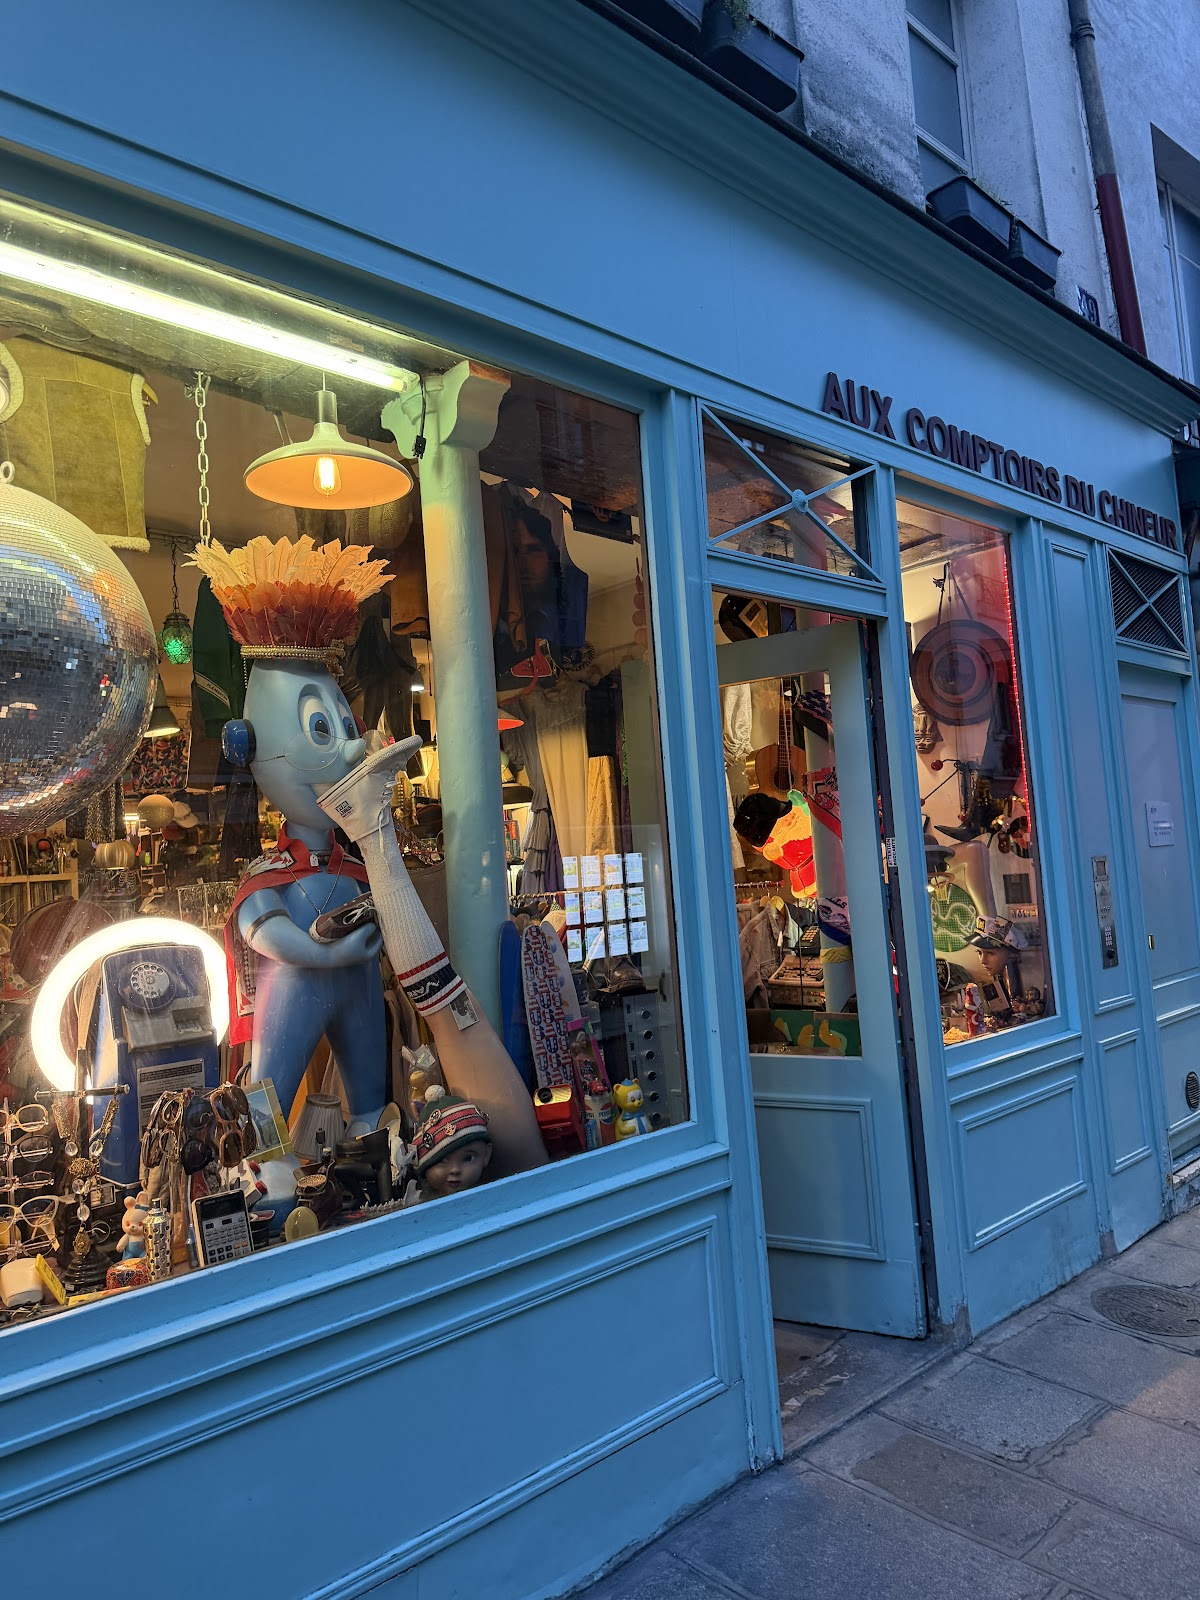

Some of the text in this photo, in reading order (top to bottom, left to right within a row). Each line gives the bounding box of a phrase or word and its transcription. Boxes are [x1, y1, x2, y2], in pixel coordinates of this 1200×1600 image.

[822, 371, 1178, 551] AUX COMPTOIRS DU CHINEUR
